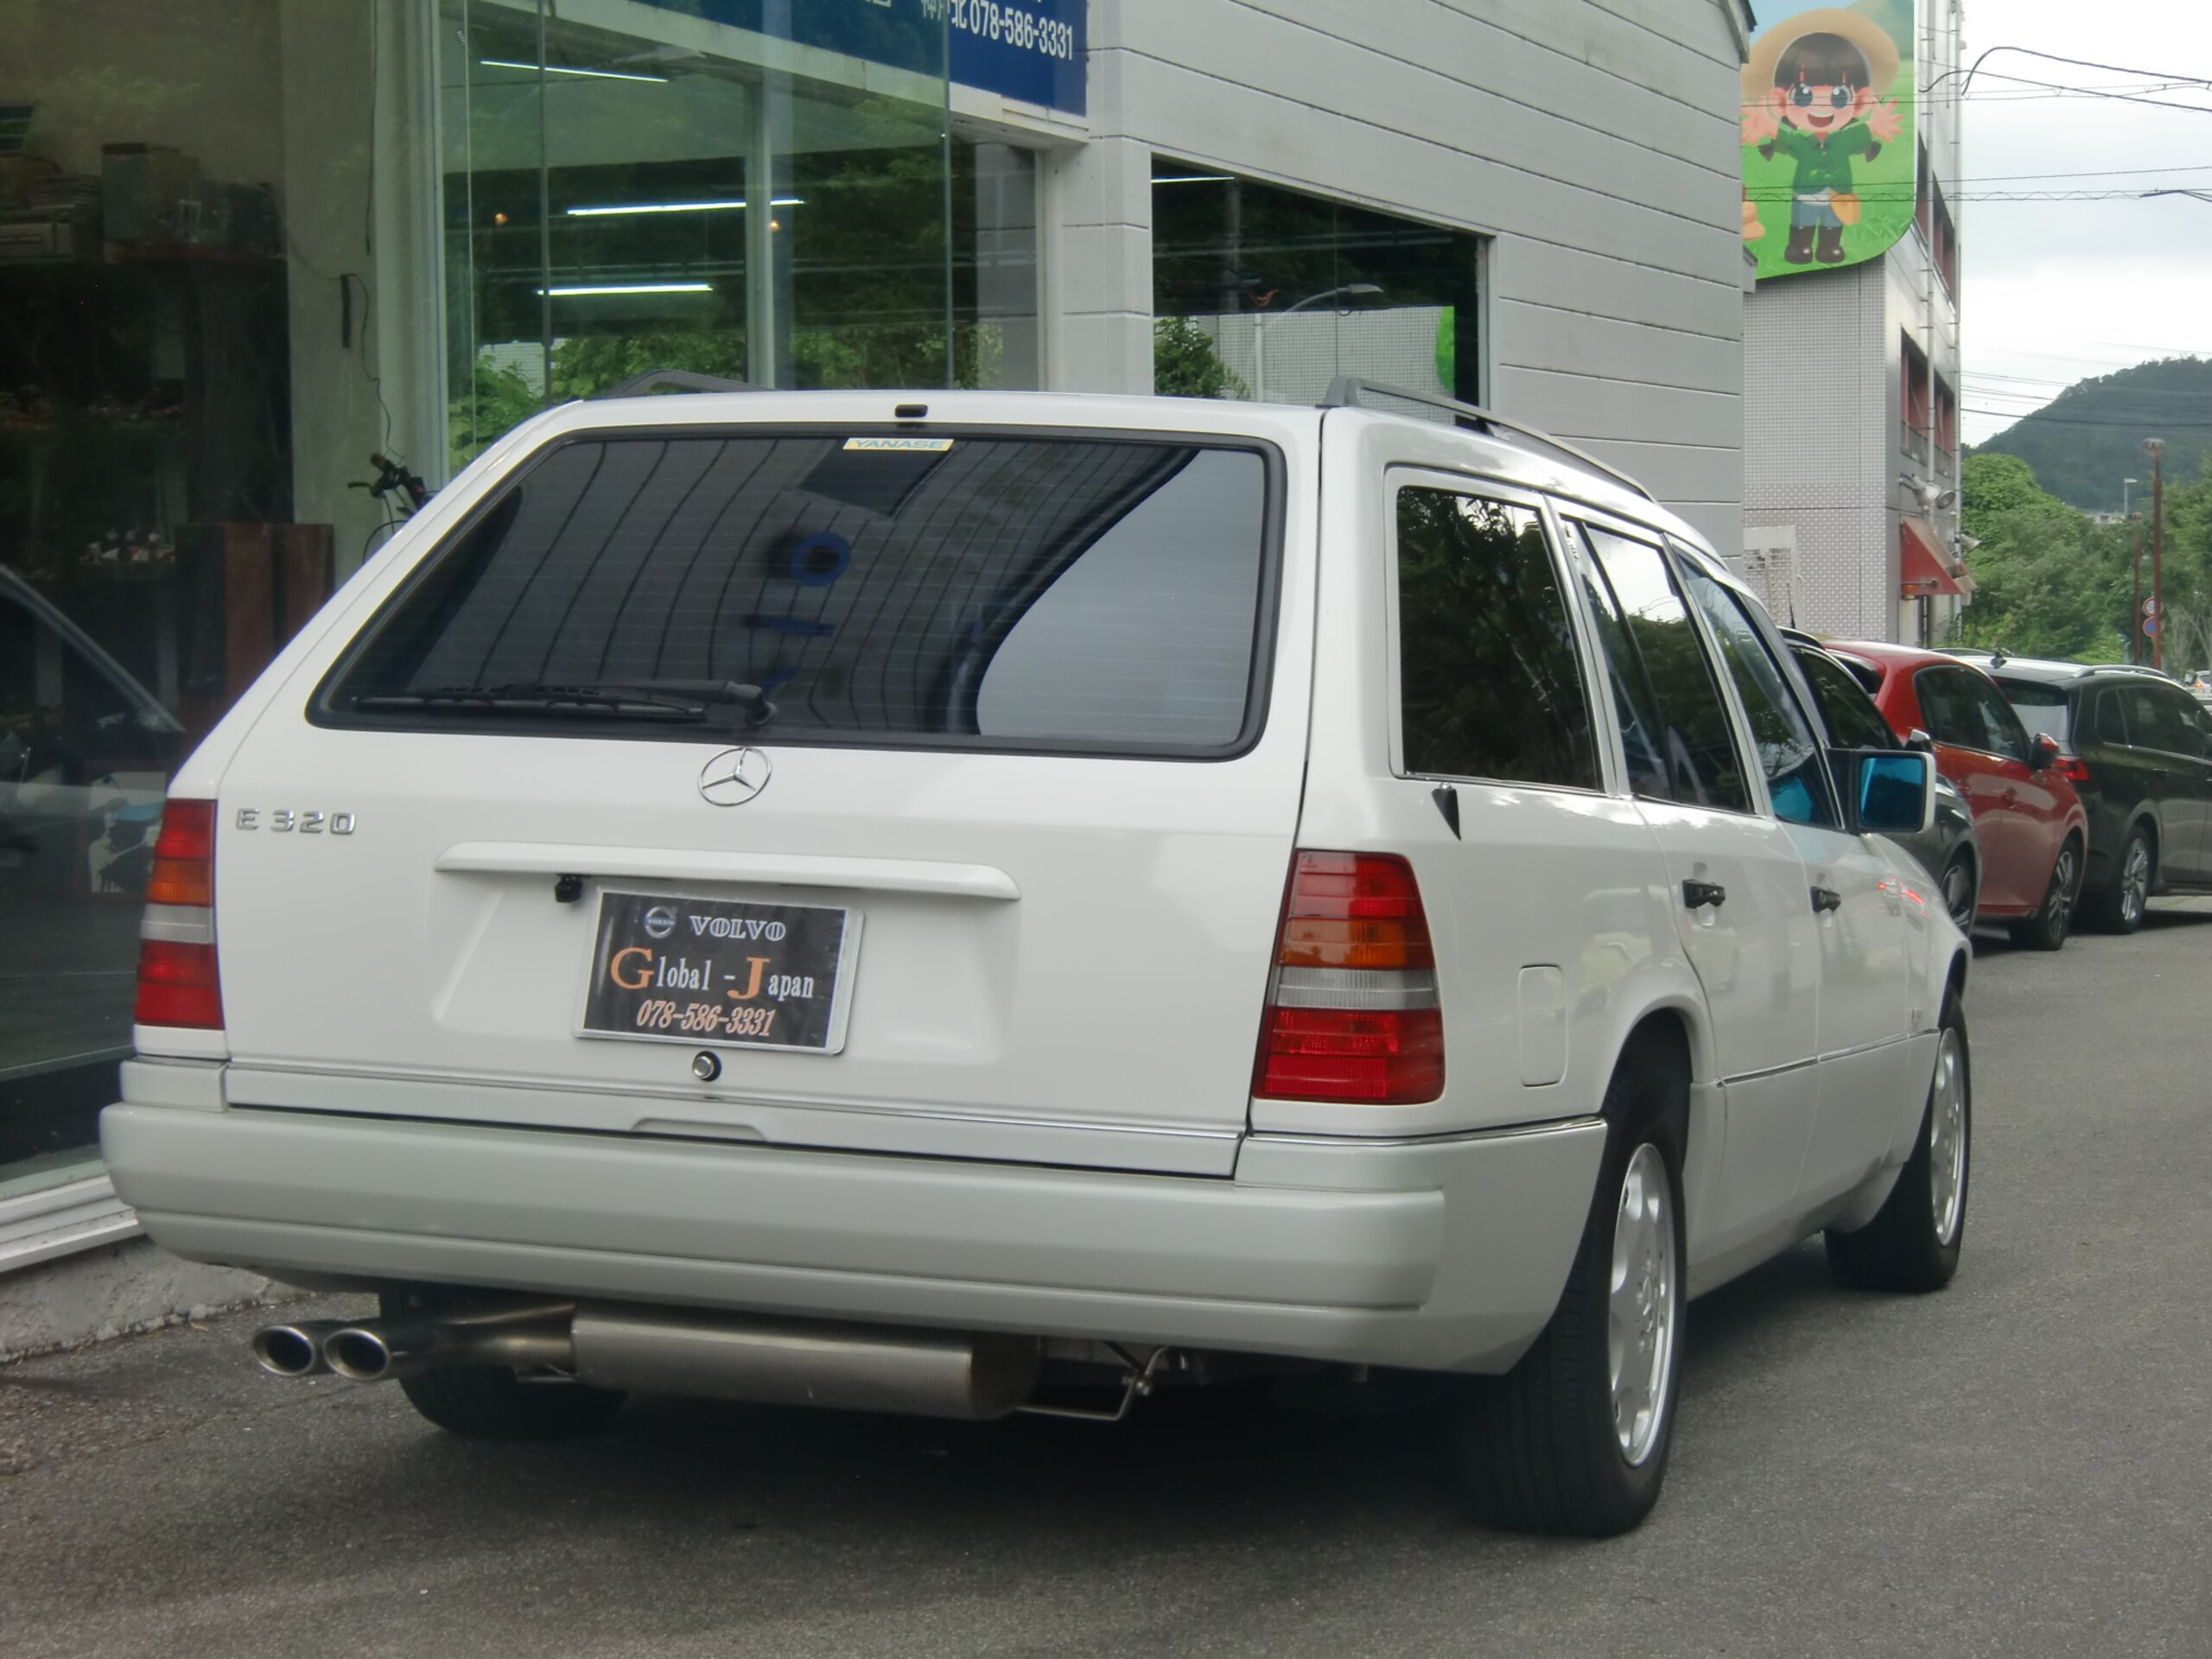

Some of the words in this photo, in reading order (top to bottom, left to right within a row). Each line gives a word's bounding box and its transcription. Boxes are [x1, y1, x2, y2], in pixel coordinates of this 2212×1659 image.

[969, 0, 1073, 60] 078-586-3331
[855, 440, 945, 448] YANASE
[235, 808, 260, 831] E
[270, 809, 357, 836] 320
[689, 915, 786, 942] VOLVO
[610, 947, 712, 991] Global
[636, 1000, 776, 1037] 078-586-3331
